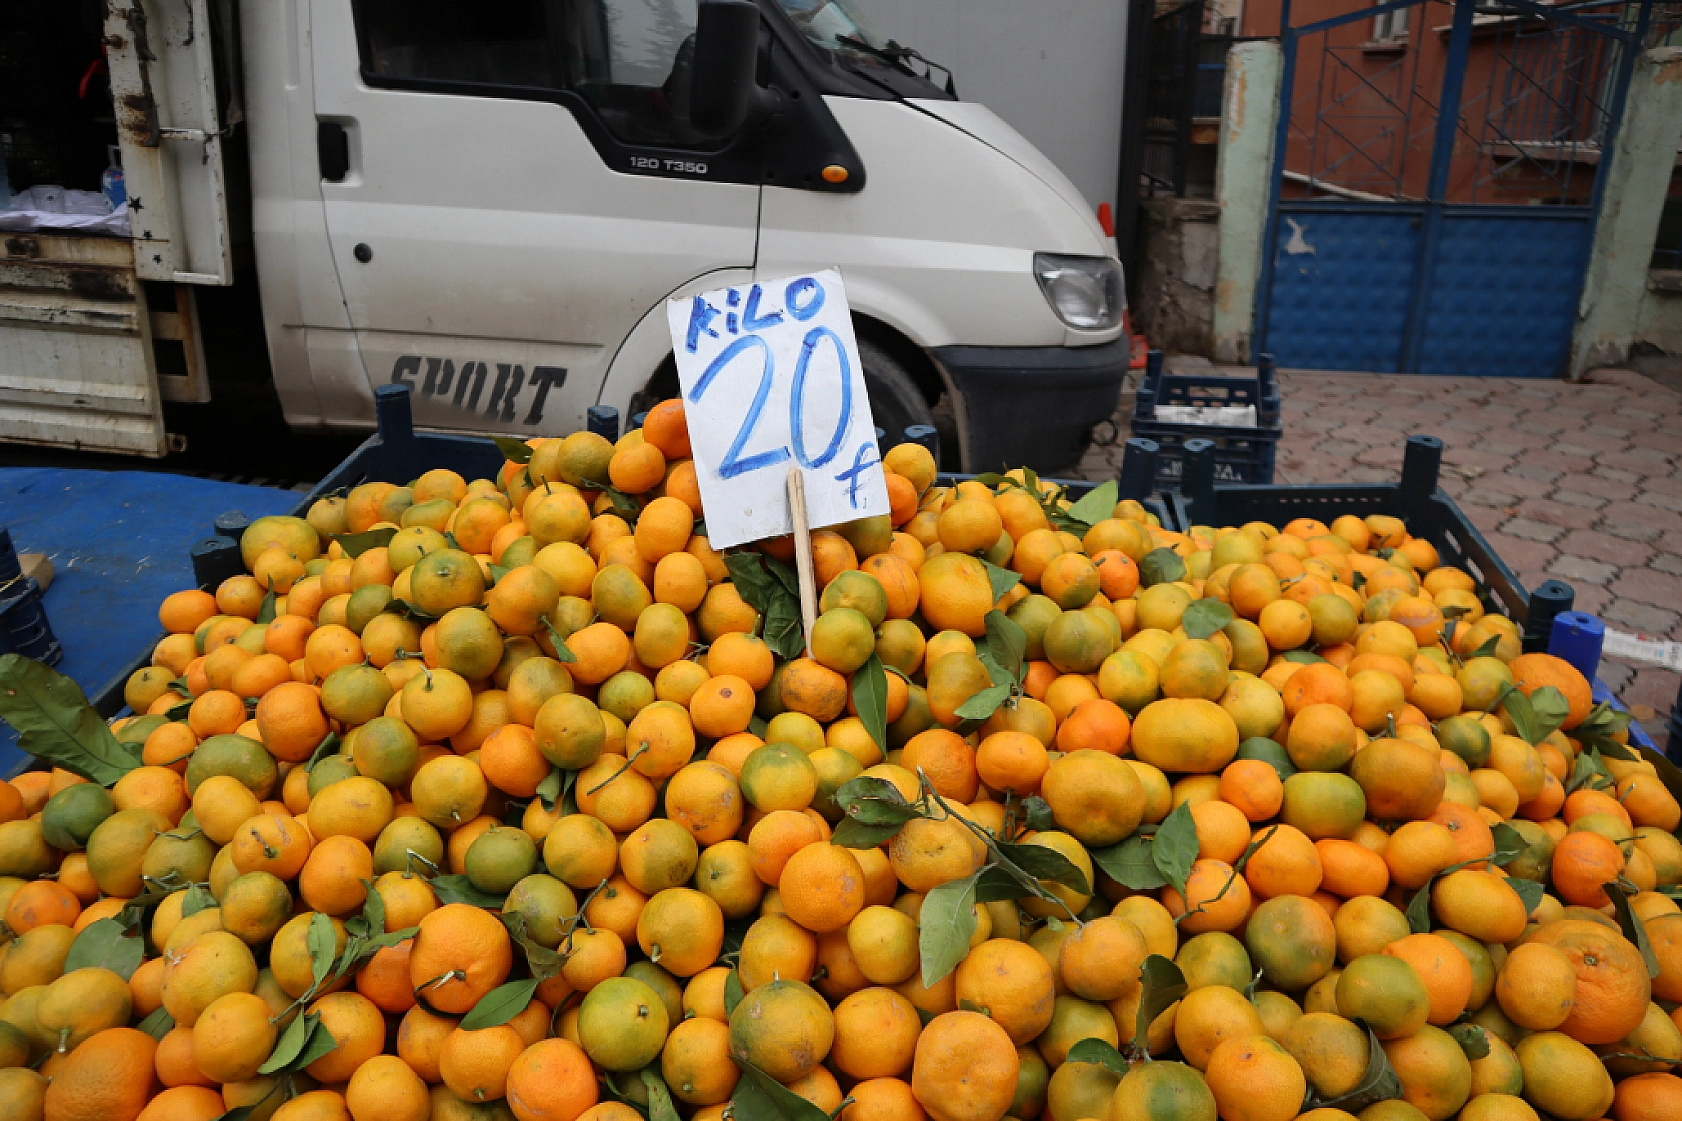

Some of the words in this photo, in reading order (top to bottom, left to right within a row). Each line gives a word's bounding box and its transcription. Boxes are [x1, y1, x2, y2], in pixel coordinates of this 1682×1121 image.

[630, 156, 659, 169] 120
[664, 159, 708, 174] T350
[391, 355, 568, 425] SPORT
[688, 325, 854, 480] 20
